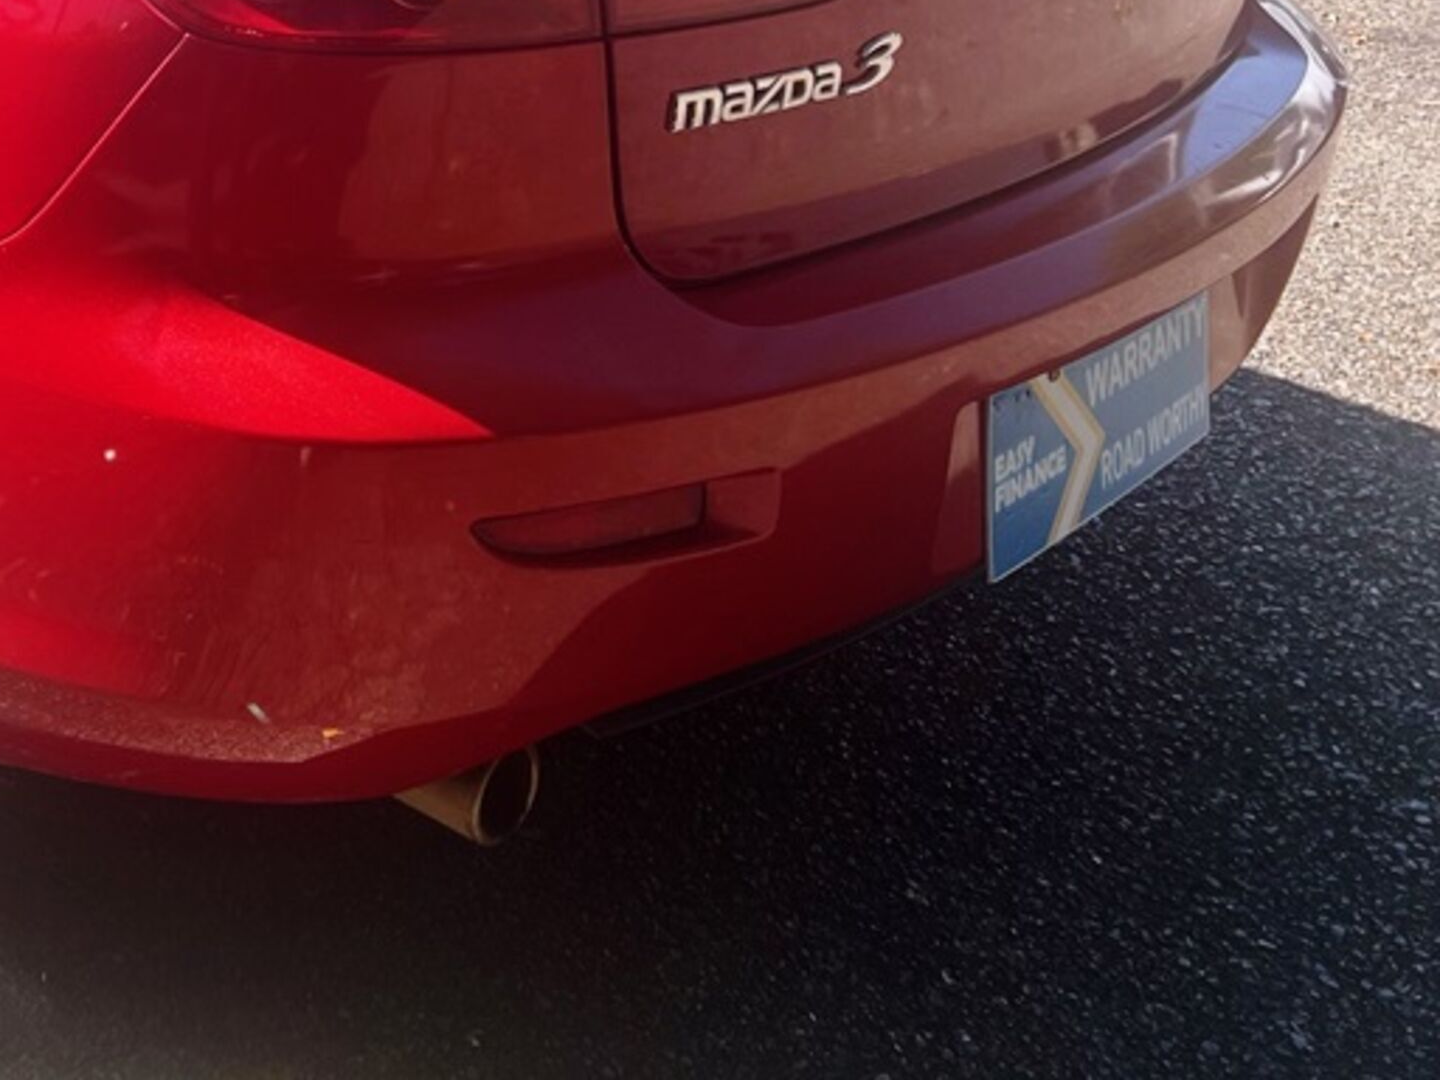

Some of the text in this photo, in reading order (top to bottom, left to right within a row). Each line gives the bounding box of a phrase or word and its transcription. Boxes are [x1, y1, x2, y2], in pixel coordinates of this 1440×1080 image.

[846, 31, 904, 96] 3
[1084, 300, 1207, 407] WARRANTY
[994, 435, 1036, 484] EASY
[994, 444, 1068, 514] FINANCE
[1101, 426, 1146, 490] ROAD
